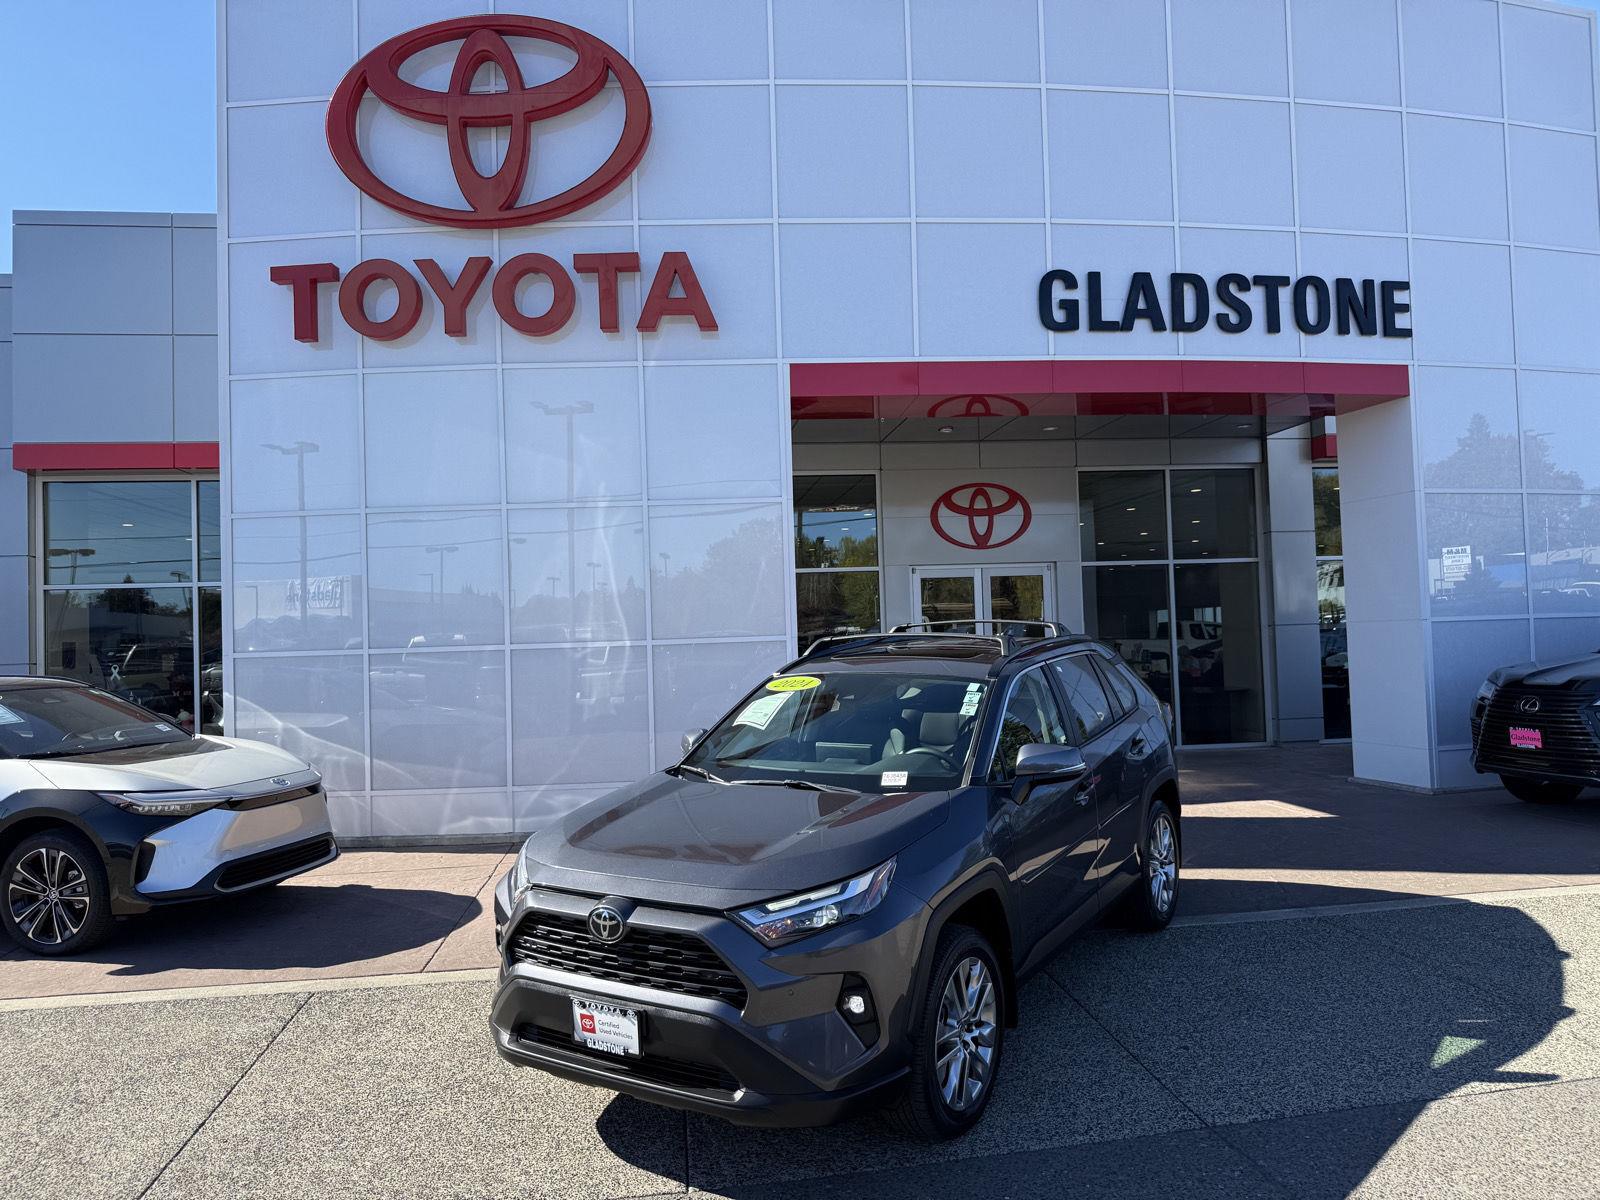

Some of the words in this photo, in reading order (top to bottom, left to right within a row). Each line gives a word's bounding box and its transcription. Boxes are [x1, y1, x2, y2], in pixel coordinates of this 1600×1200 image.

[270, 251, 719, 343] TOYOTA
[1038, 269, 1413, 338] GLADSTONE
[586, 1001, 622, 1014] TOYOTA
[598, 1019, 620, 1029] Certified
[612, 1030, 633, 1040] Vehicles
[586, 1038, 625, 1056] GLADSTONE
